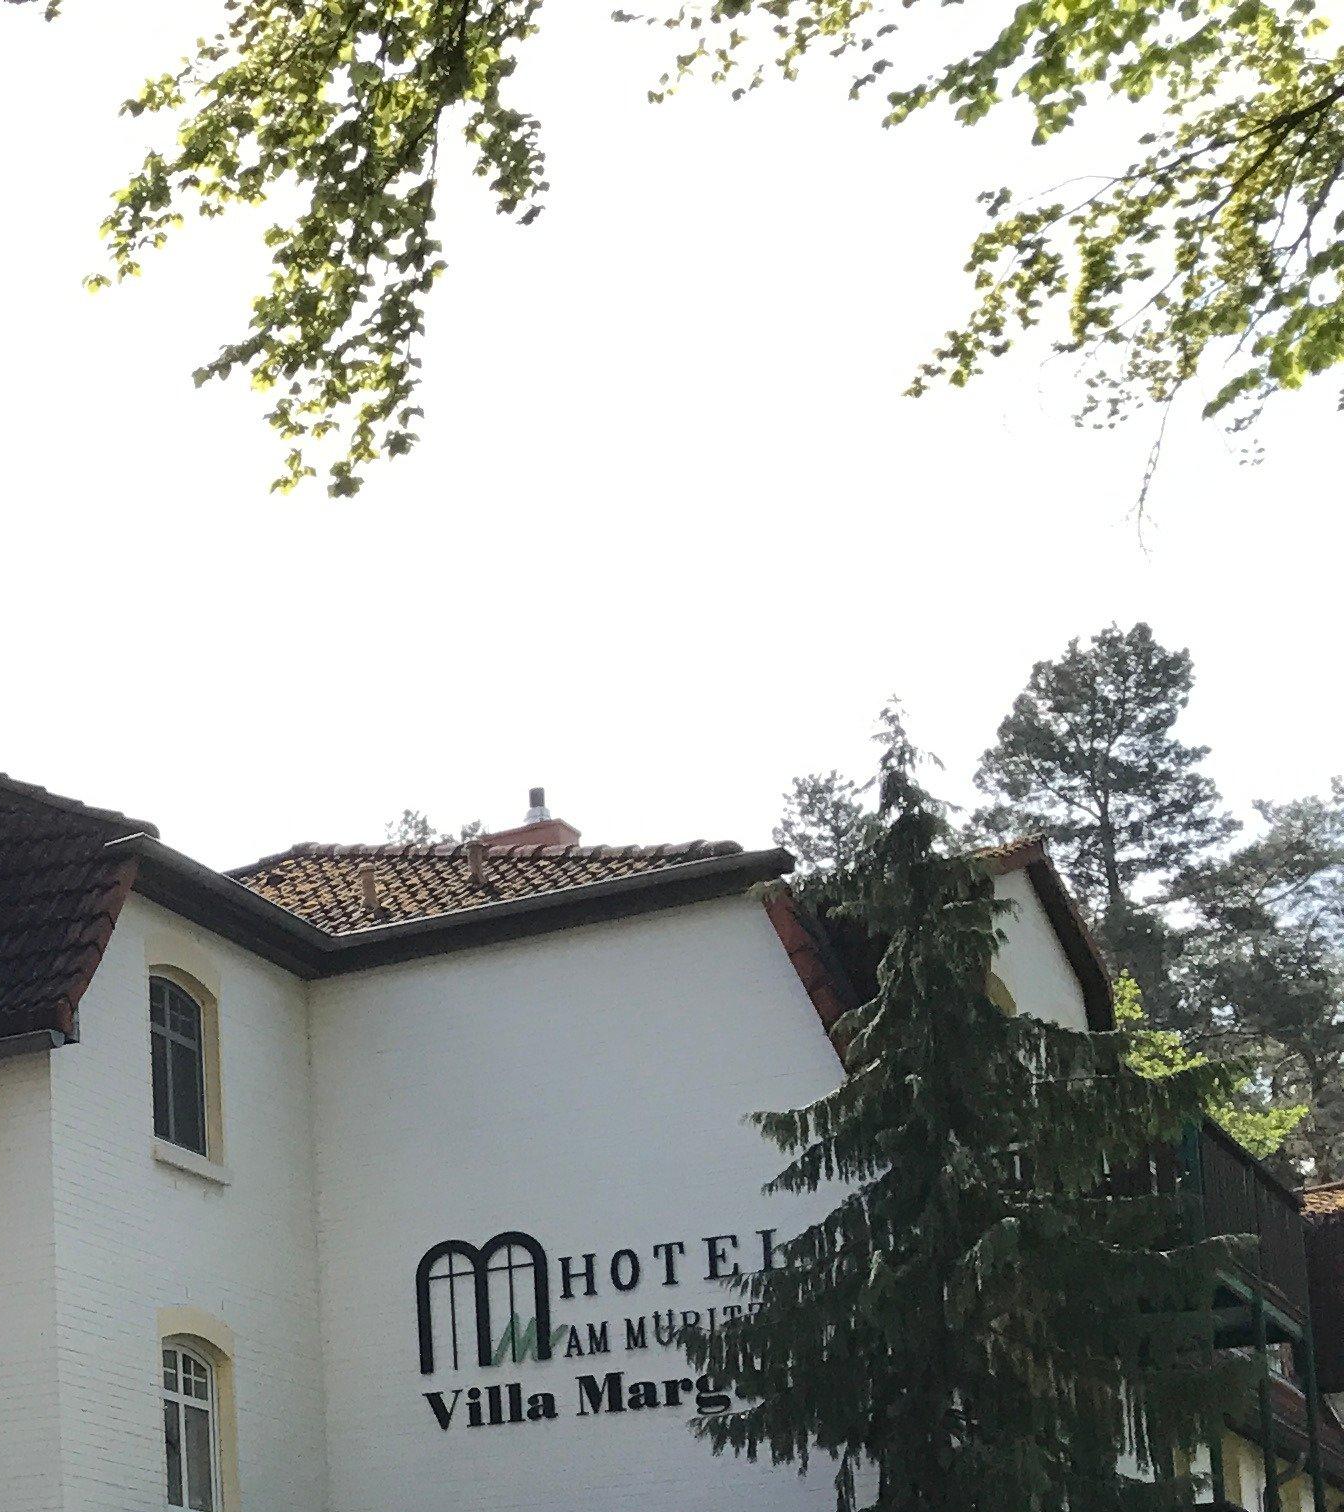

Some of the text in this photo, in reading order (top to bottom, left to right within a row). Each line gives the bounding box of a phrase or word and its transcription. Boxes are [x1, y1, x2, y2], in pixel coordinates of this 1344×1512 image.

[558, 1228, 779, 1299] HOTEL
[564, 1321, 611, 1358] AM
[422, 1370, 748, 1431] Villa Marg
